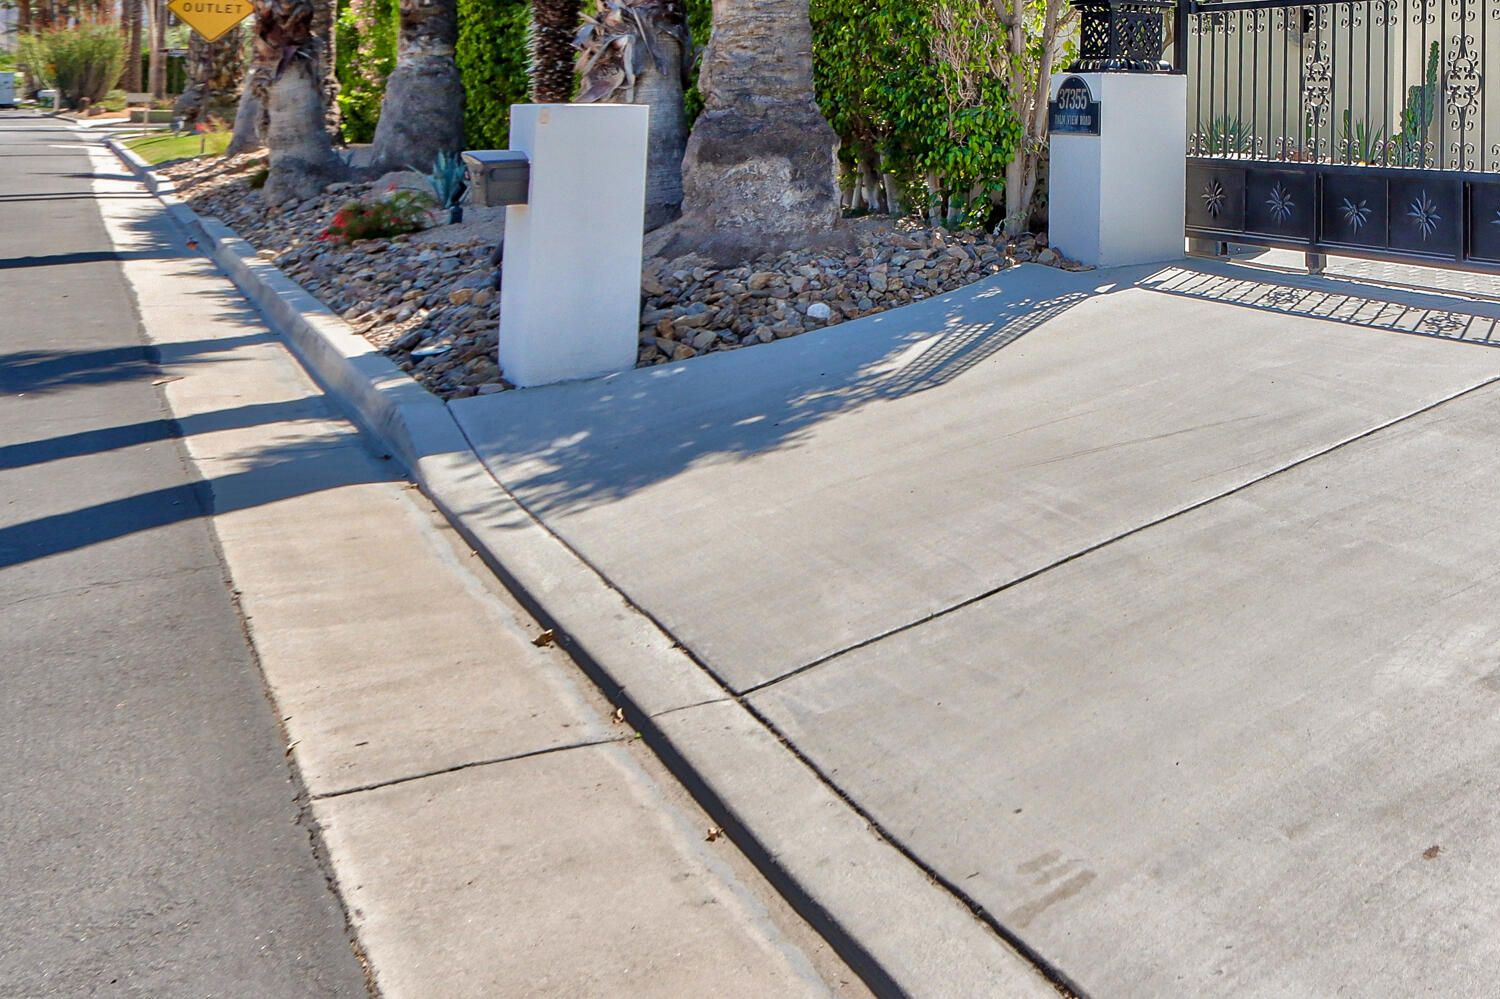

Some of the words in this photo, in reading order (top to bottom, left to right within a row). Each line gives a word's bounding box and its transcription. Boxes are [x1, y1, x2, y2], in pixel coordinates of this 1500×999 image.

[183, 2, 242, 14] OUTLET
[1058, 88, 1087, 109] 37355
[1066, 114, 1079, 125] VIEW
[1079, 115, 1092, 126] ROAD
